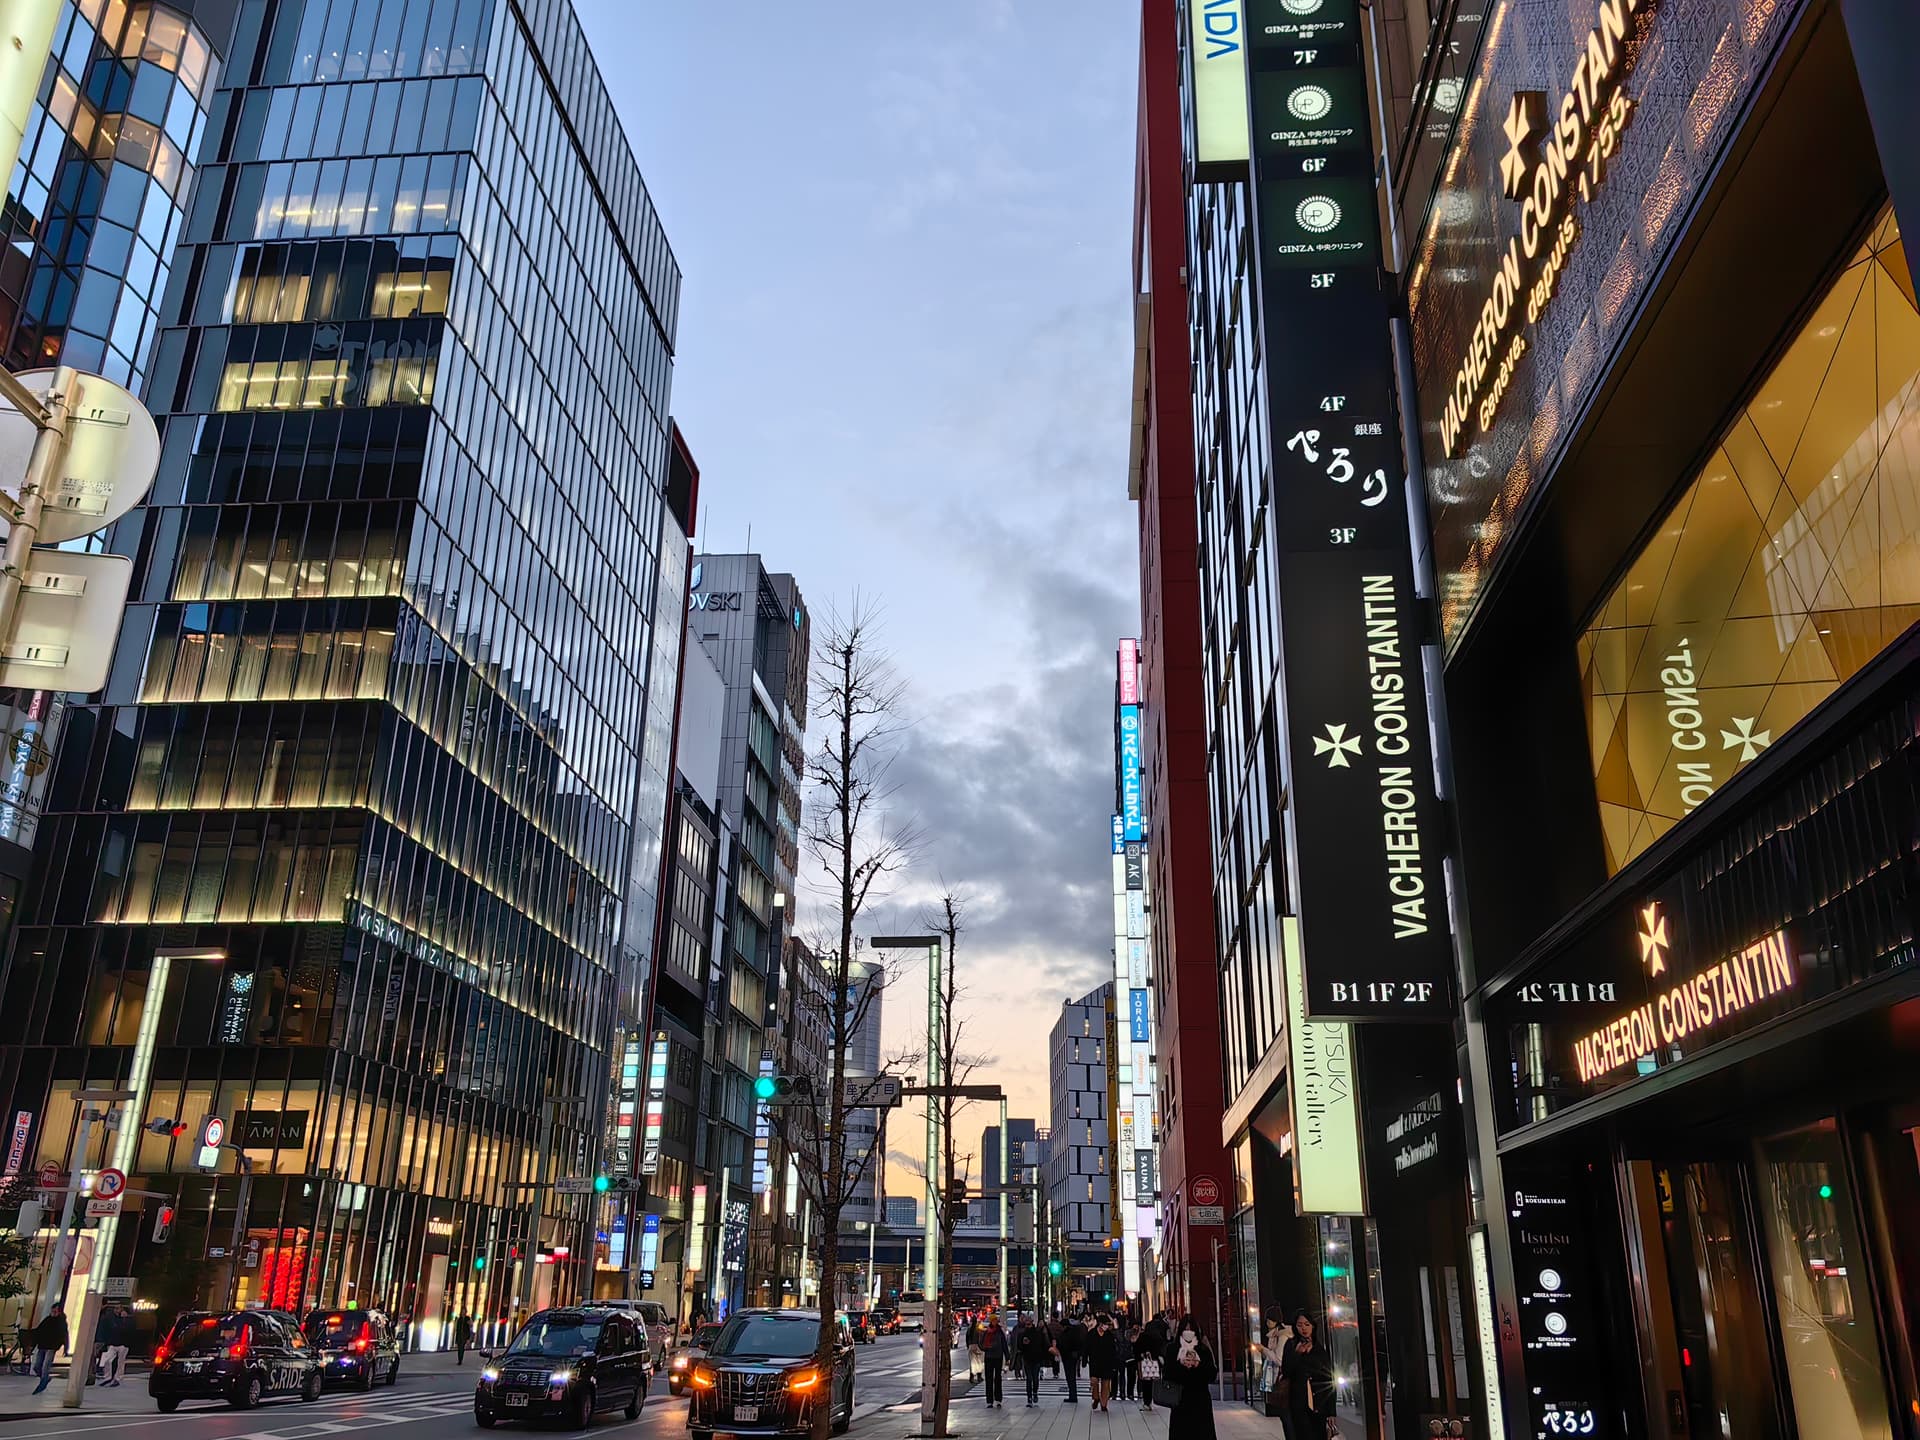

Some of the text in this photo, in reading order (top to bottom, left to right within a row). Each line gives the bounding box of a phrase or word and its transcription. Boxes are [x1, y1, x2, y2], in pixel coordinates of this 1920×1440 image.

[1264, 24, 1299, 34] GINZA
[1293, 50, 1318, 65] 7F
[1271, 131, 1306, 140] GINZA
[1302, 158, 1327, 172] 6F
[1439, 0, 1637, 458] VACHERON CONSTAN
[1278, 242, 1364, 254] GINZA 中央クリニック
[1527, 213, 1575, 324] depuis
[1310, 273, 1335, 288] 5F
[1320, 395, 1345, 412] 4F
[1354, 423, 1383, 436] 銀座
[1287, 429, 1388, 507] ぺろり
[1329, 528, 1356, 544] 3F
[1361, 575, 1428, 940] VACHERON CONSTANTIN
[1124, 733, 1140, 830] スペーストラスト
[1331, 982, 1433, 1002] B1 1F 2F
[1135, 992, 1143, 1038] TORAIZ
[1575, 930, 1793, 1083] VACHERON CONSTANTIN
[222, 997, 236, 1043] CLINIC
[229, 998, 243, 1043] HIMAWARI
[1140, 1155, 1149, 1190] SAUNA
[1542, 1410, 1594, 1433] ぺろり
